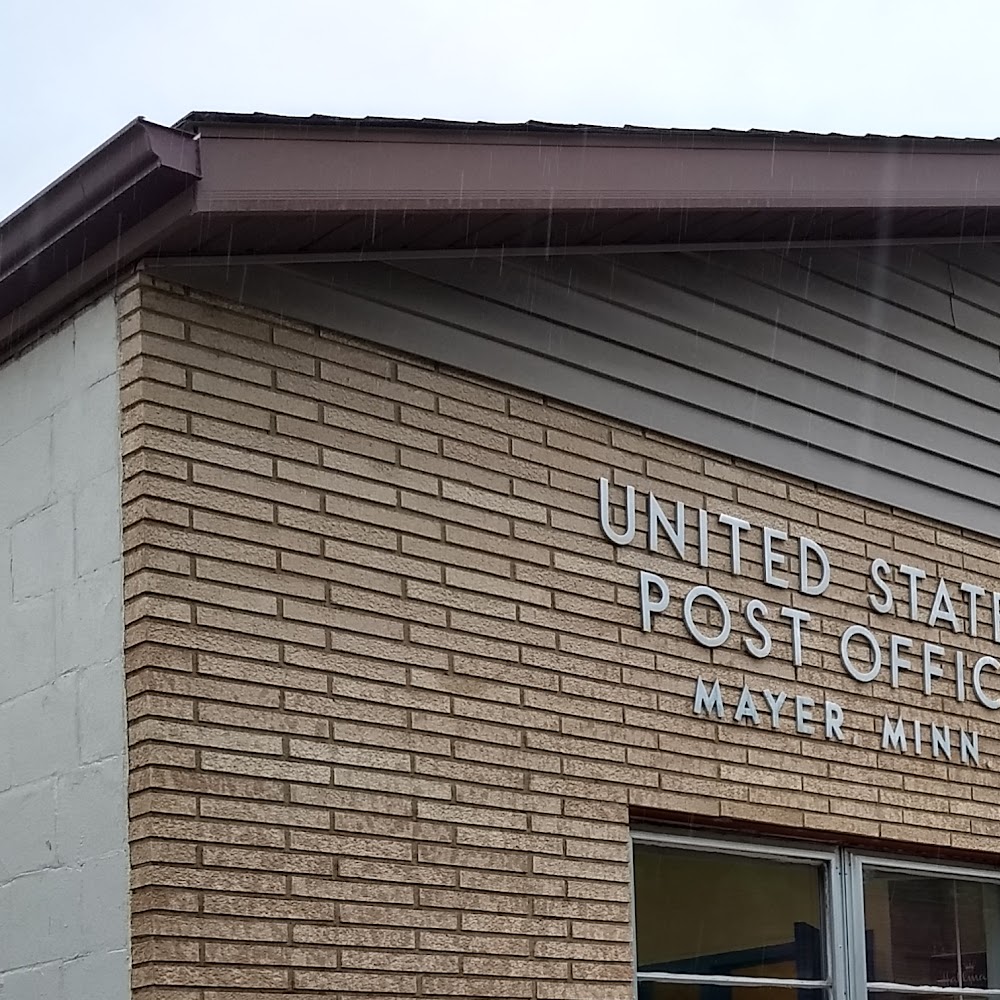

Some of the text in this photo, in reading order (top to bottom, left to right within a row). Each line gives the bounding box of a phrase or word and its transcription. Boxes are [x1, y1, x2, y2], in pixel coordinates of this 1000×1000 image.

[600, 476, 831, 596] UNITED
[639, 570, 812, 667] POST
[693, 674, 845, 741] MAYER
